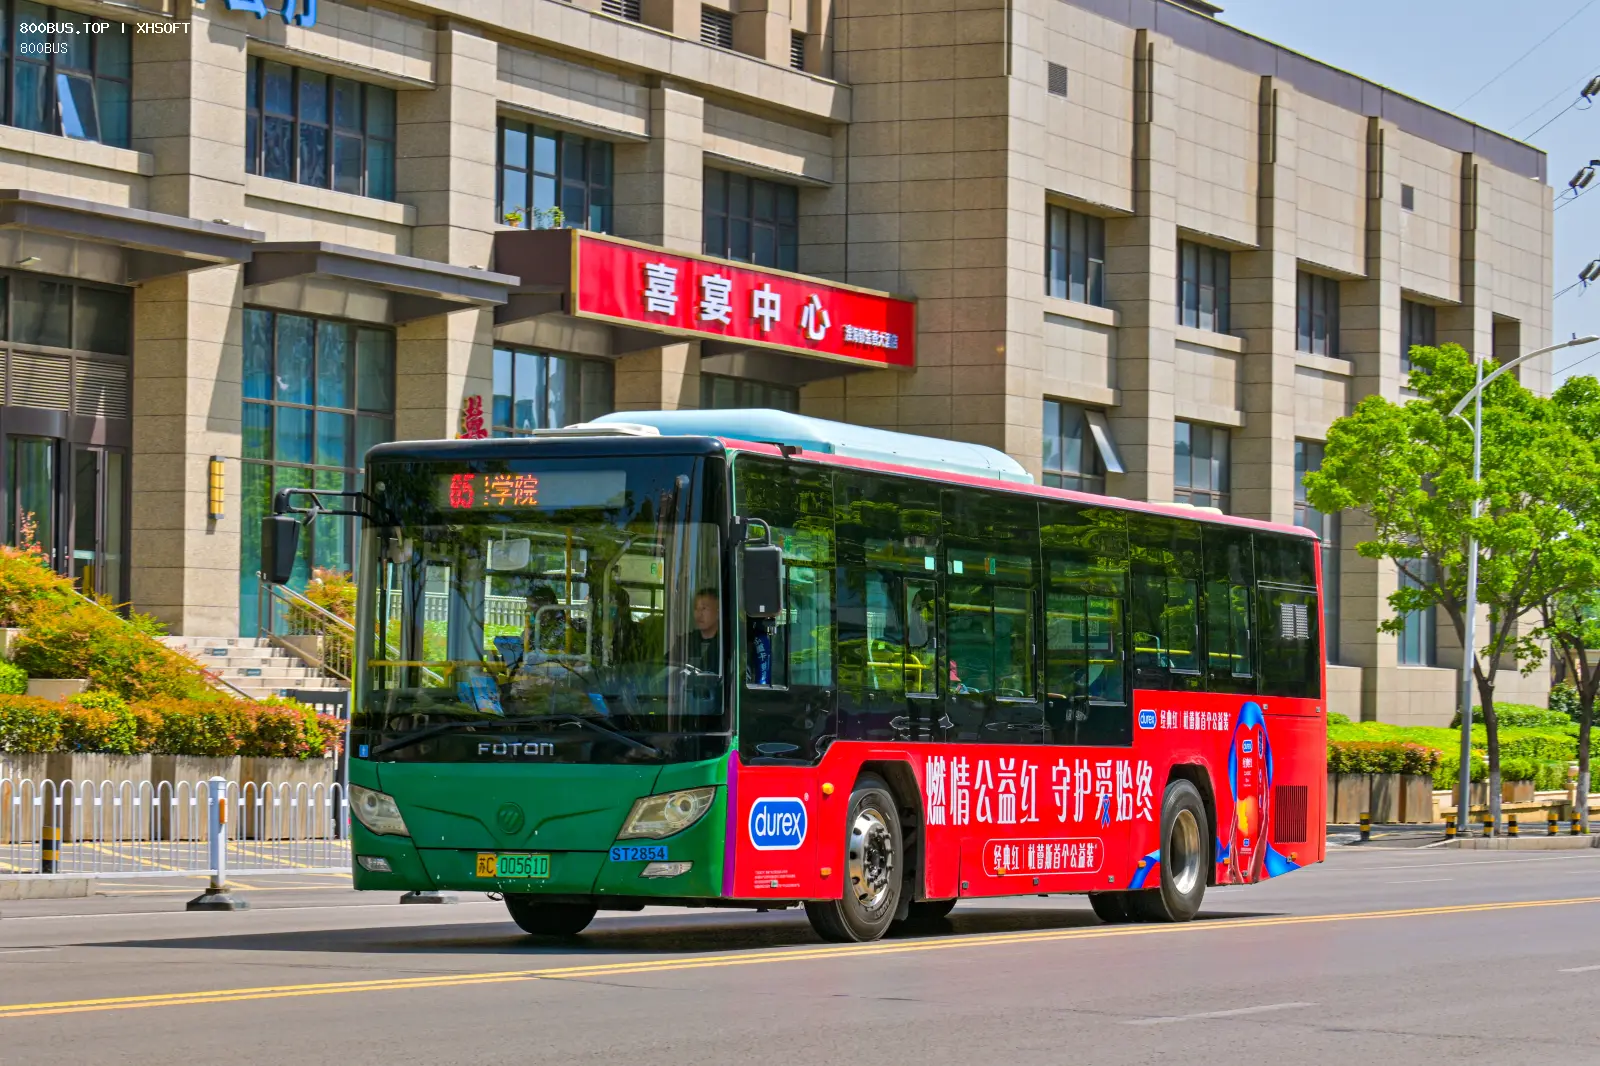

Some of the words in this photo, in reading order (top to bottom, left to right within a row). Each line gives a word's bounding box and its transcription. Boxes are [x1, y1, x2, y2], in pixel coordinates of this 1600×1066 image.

[643, 262, 831, 341] 喜宴中心
[484, 474, 538, 505] 学院
[477, 742, 554, 755] FOTON
[925, 755, 1039, 825] 燃情公益红
[1051, 758, 1153, 822] 守护爱始终
[755, 805, 802, 841] durex
[612, 847, 665, 861] ST2854
[993, 844, 1019, 870] 经典红
